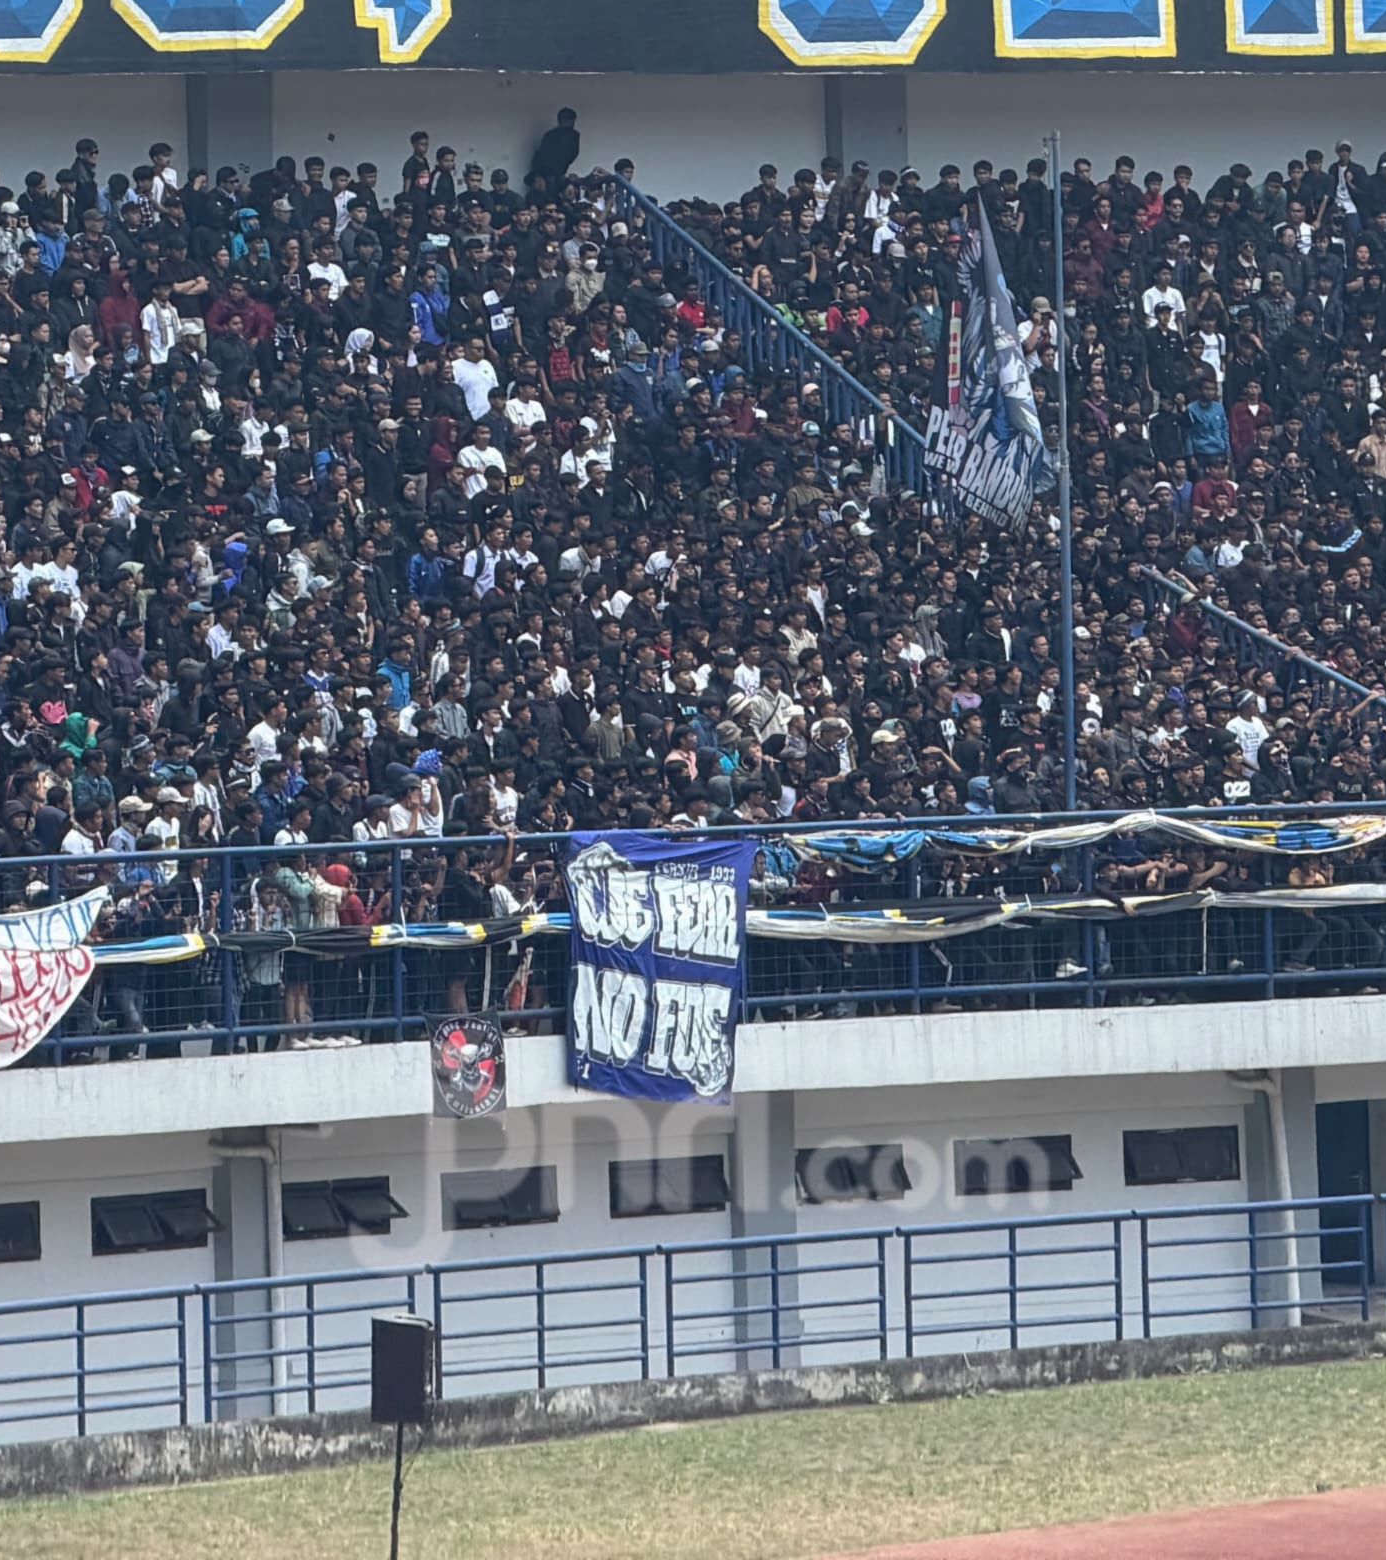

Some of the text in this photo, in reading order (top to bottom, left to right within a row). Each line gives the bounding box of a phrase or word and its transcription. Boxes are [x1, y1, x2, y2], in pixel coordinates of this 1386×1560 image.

[572, 867, 740, 968] WE FEAR
[572, 961, 732, 1080] NO FOE
